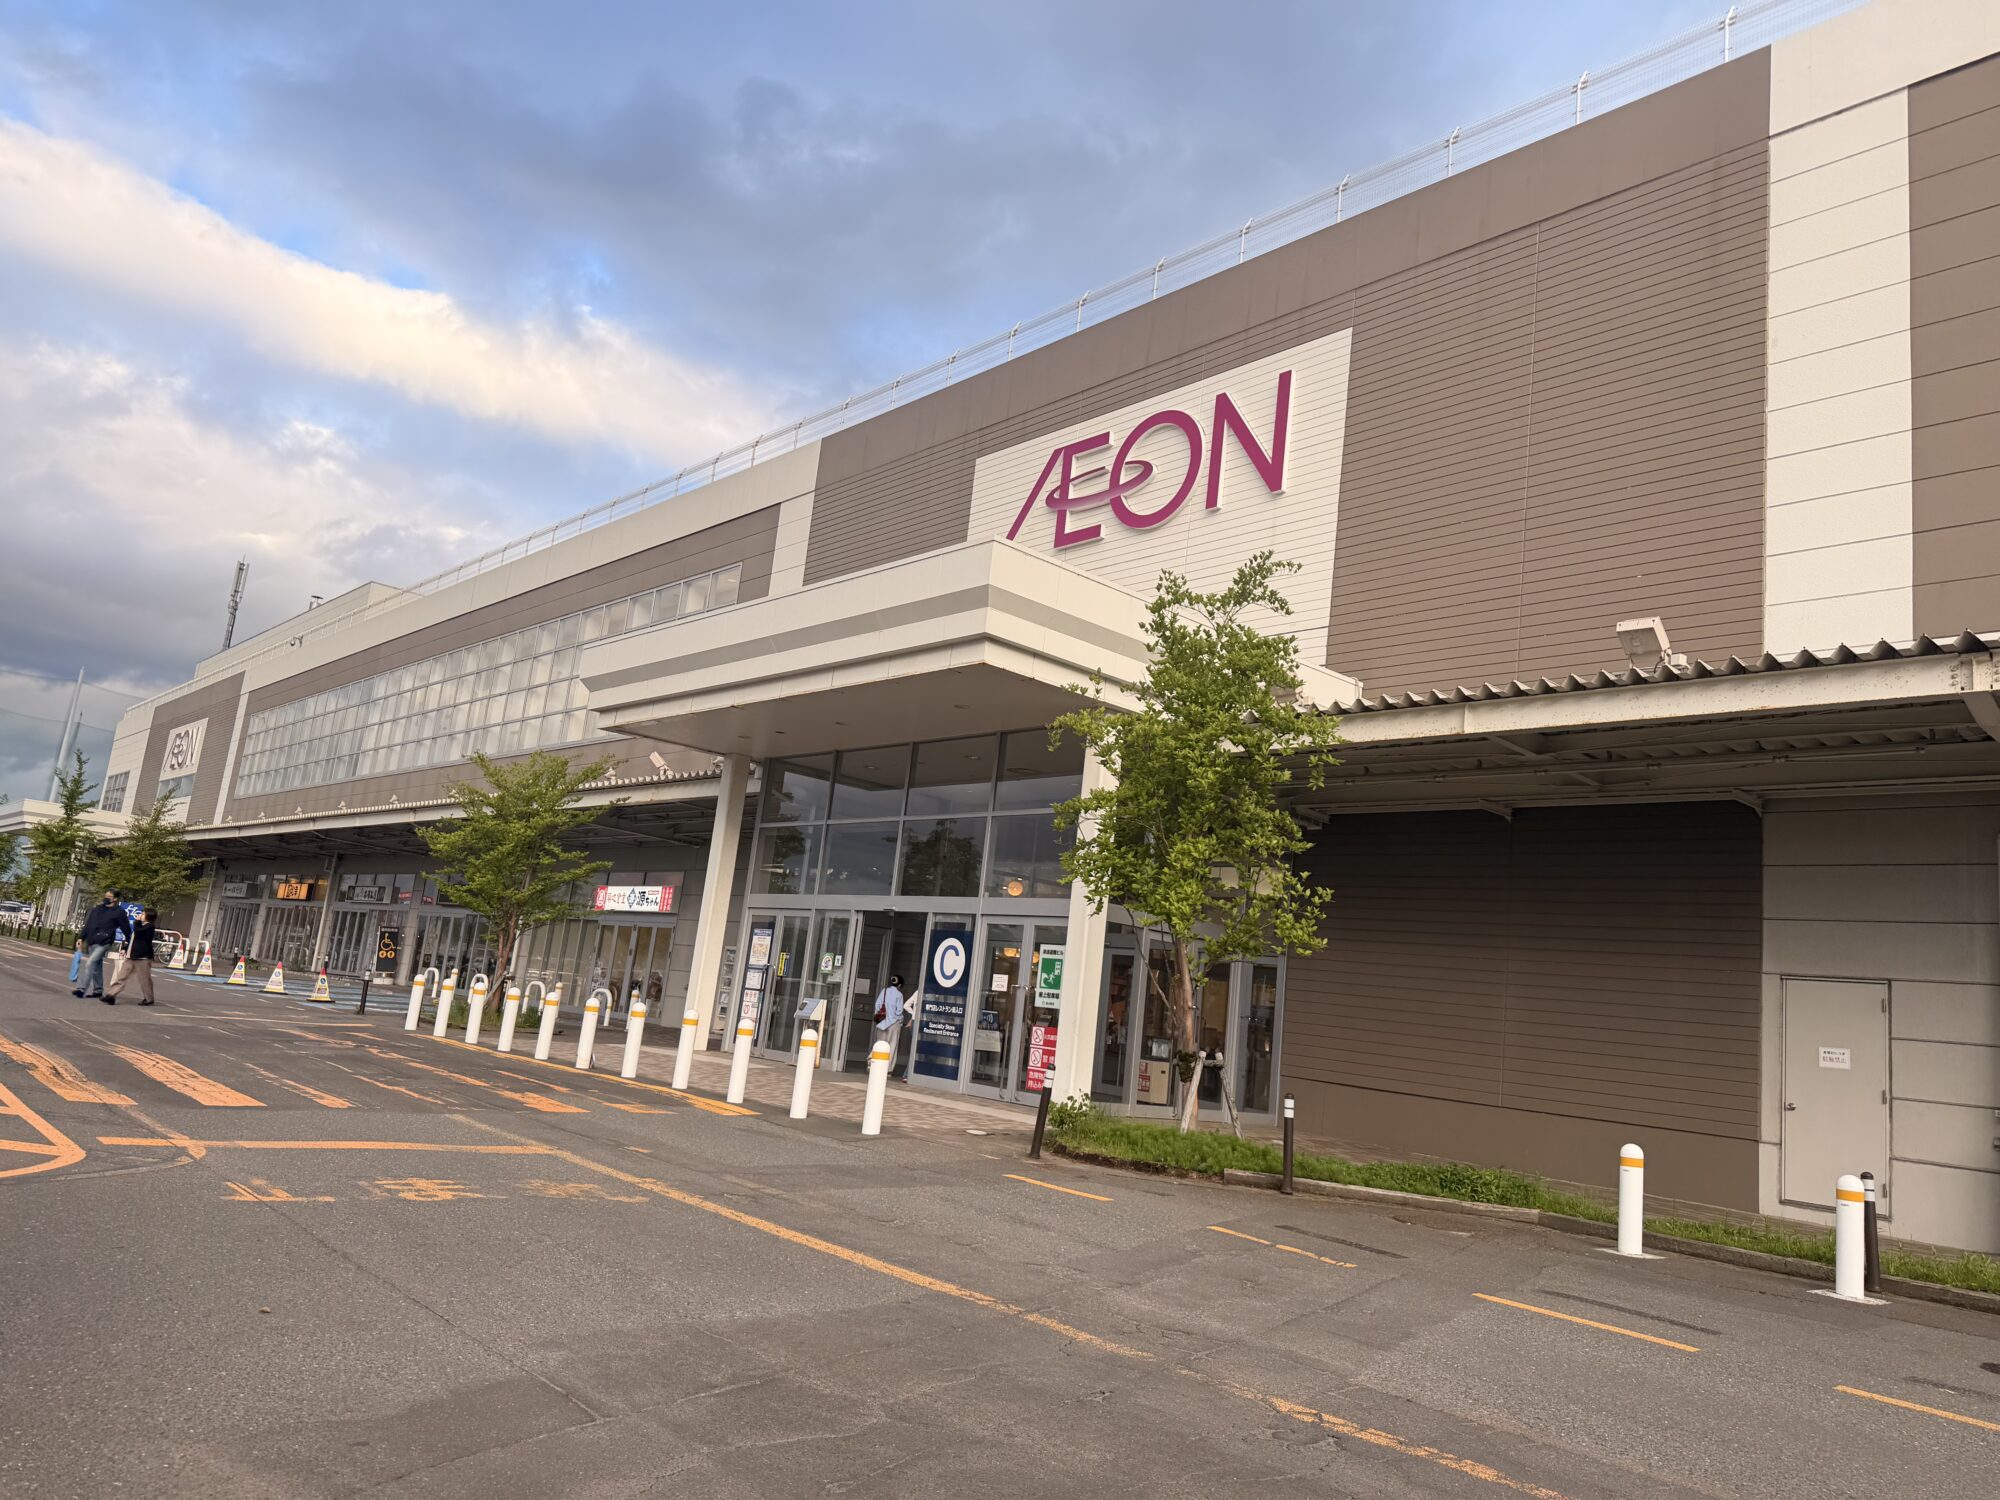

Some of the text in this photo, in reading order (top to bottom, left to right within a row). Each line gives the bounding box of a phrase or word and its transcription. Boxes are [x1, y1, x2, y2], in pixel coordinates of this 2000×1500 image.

[1006, 369, 1295, 548] AEON
[162, 725, 200, 771] AEON
[940, 944, 960, 980] C
[923, 1027, 943, 1035] Restaurant
[929, 1022, 945, 1030] Specialty
